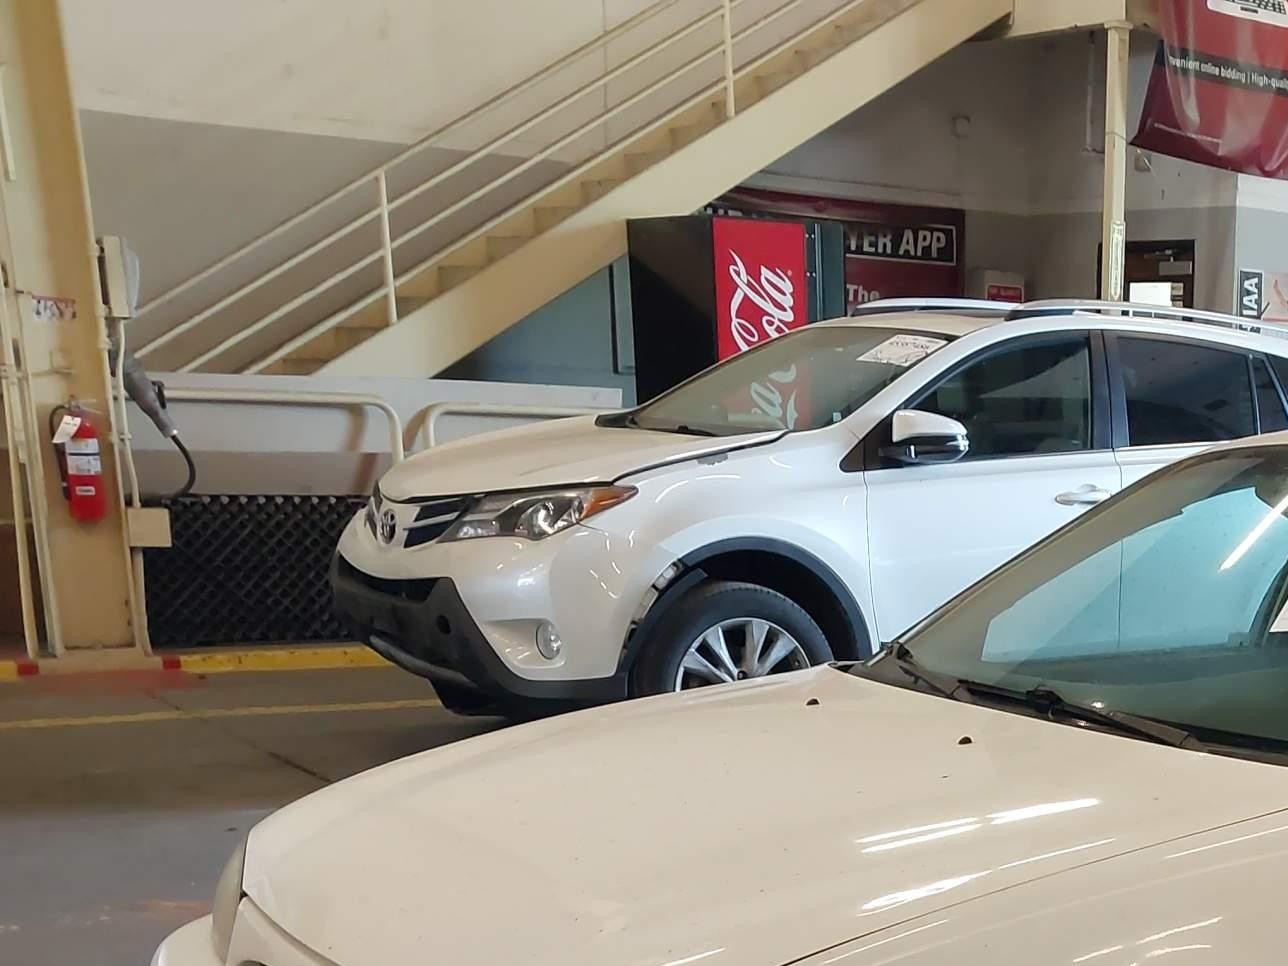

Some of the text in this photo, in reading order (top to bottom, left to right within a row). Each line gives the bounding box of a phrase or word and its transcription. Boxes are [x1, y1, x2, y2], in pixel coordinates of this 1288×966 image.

[846, 228, 946, 258] YER APP
[845, 283, 880, 303] The
[1243, 277, 1258, 316] IAA
